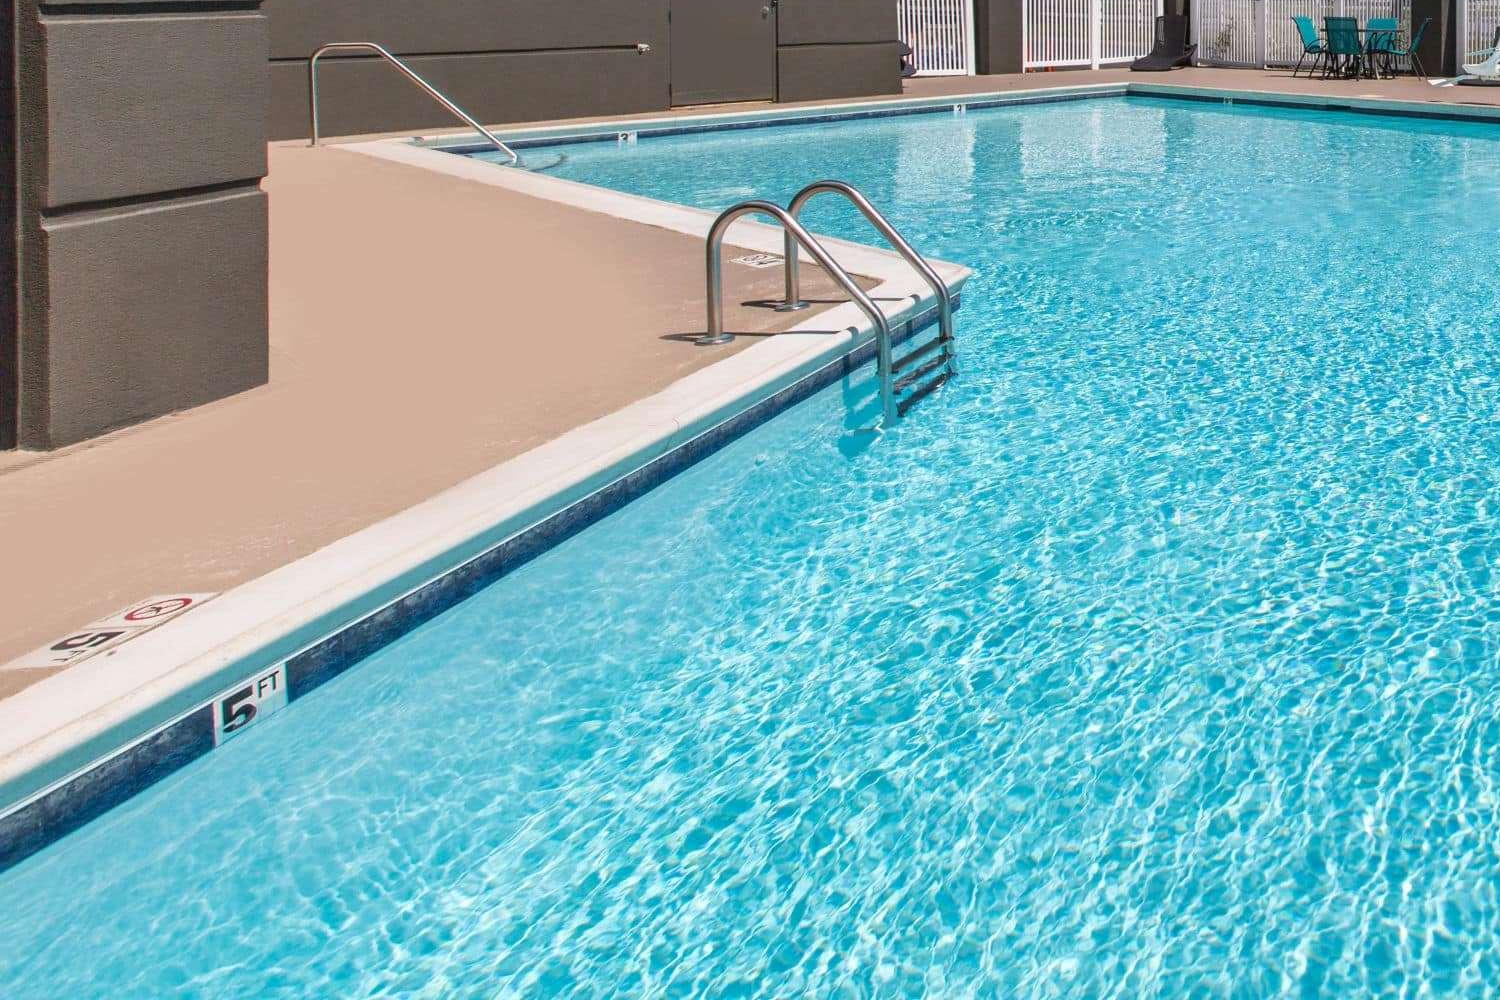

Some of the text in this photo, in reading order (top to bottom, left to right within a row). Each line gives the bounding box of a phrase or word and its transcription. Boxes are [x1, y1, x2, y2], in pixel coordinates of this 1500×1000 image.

[50, 630, 126, 651] 5
[222, 670, 280, 733] 5 FT
